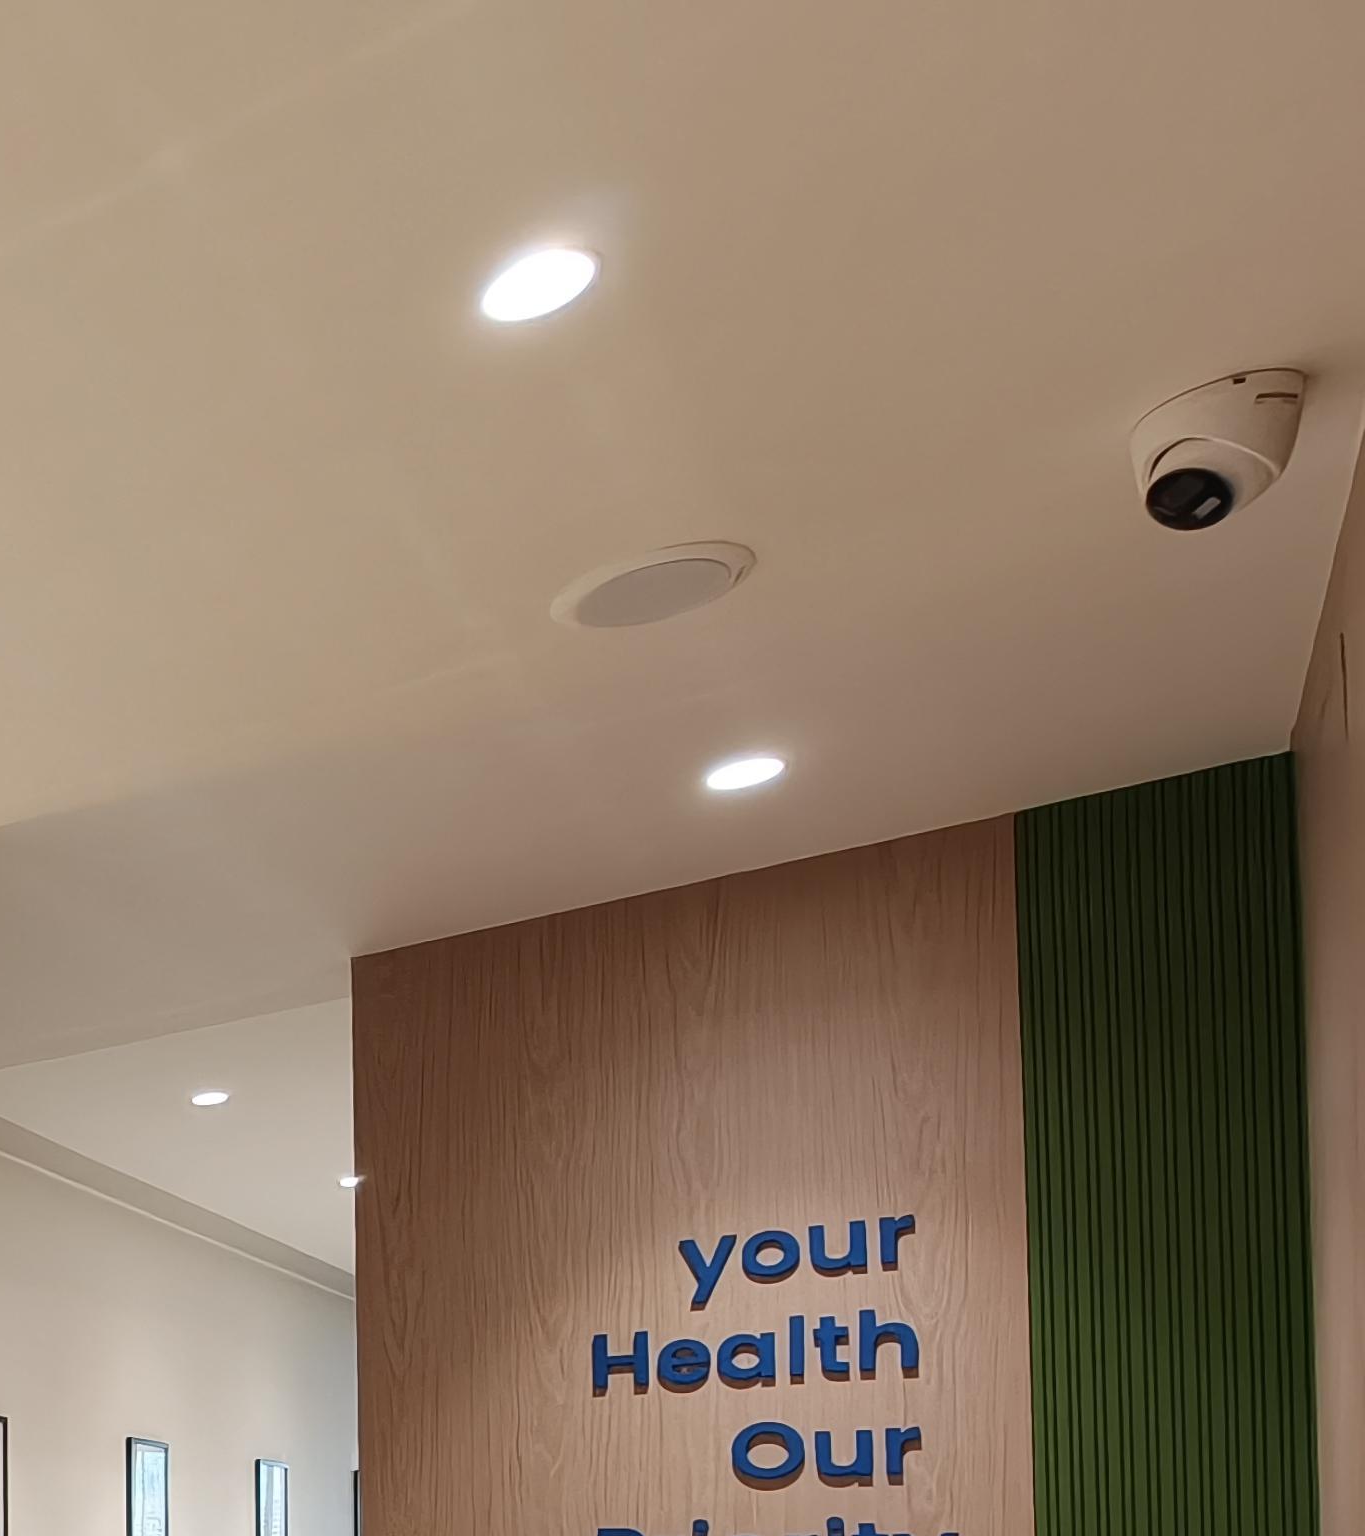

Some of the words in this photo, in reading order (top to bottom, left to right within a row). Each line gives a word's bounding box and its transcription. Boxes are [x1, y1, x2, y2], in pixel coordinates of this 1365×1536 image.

[678, 1214, 916, 1311] your
[591, 1309, 920, 1397] Health
[731, 1421, 922, 1491] Our
